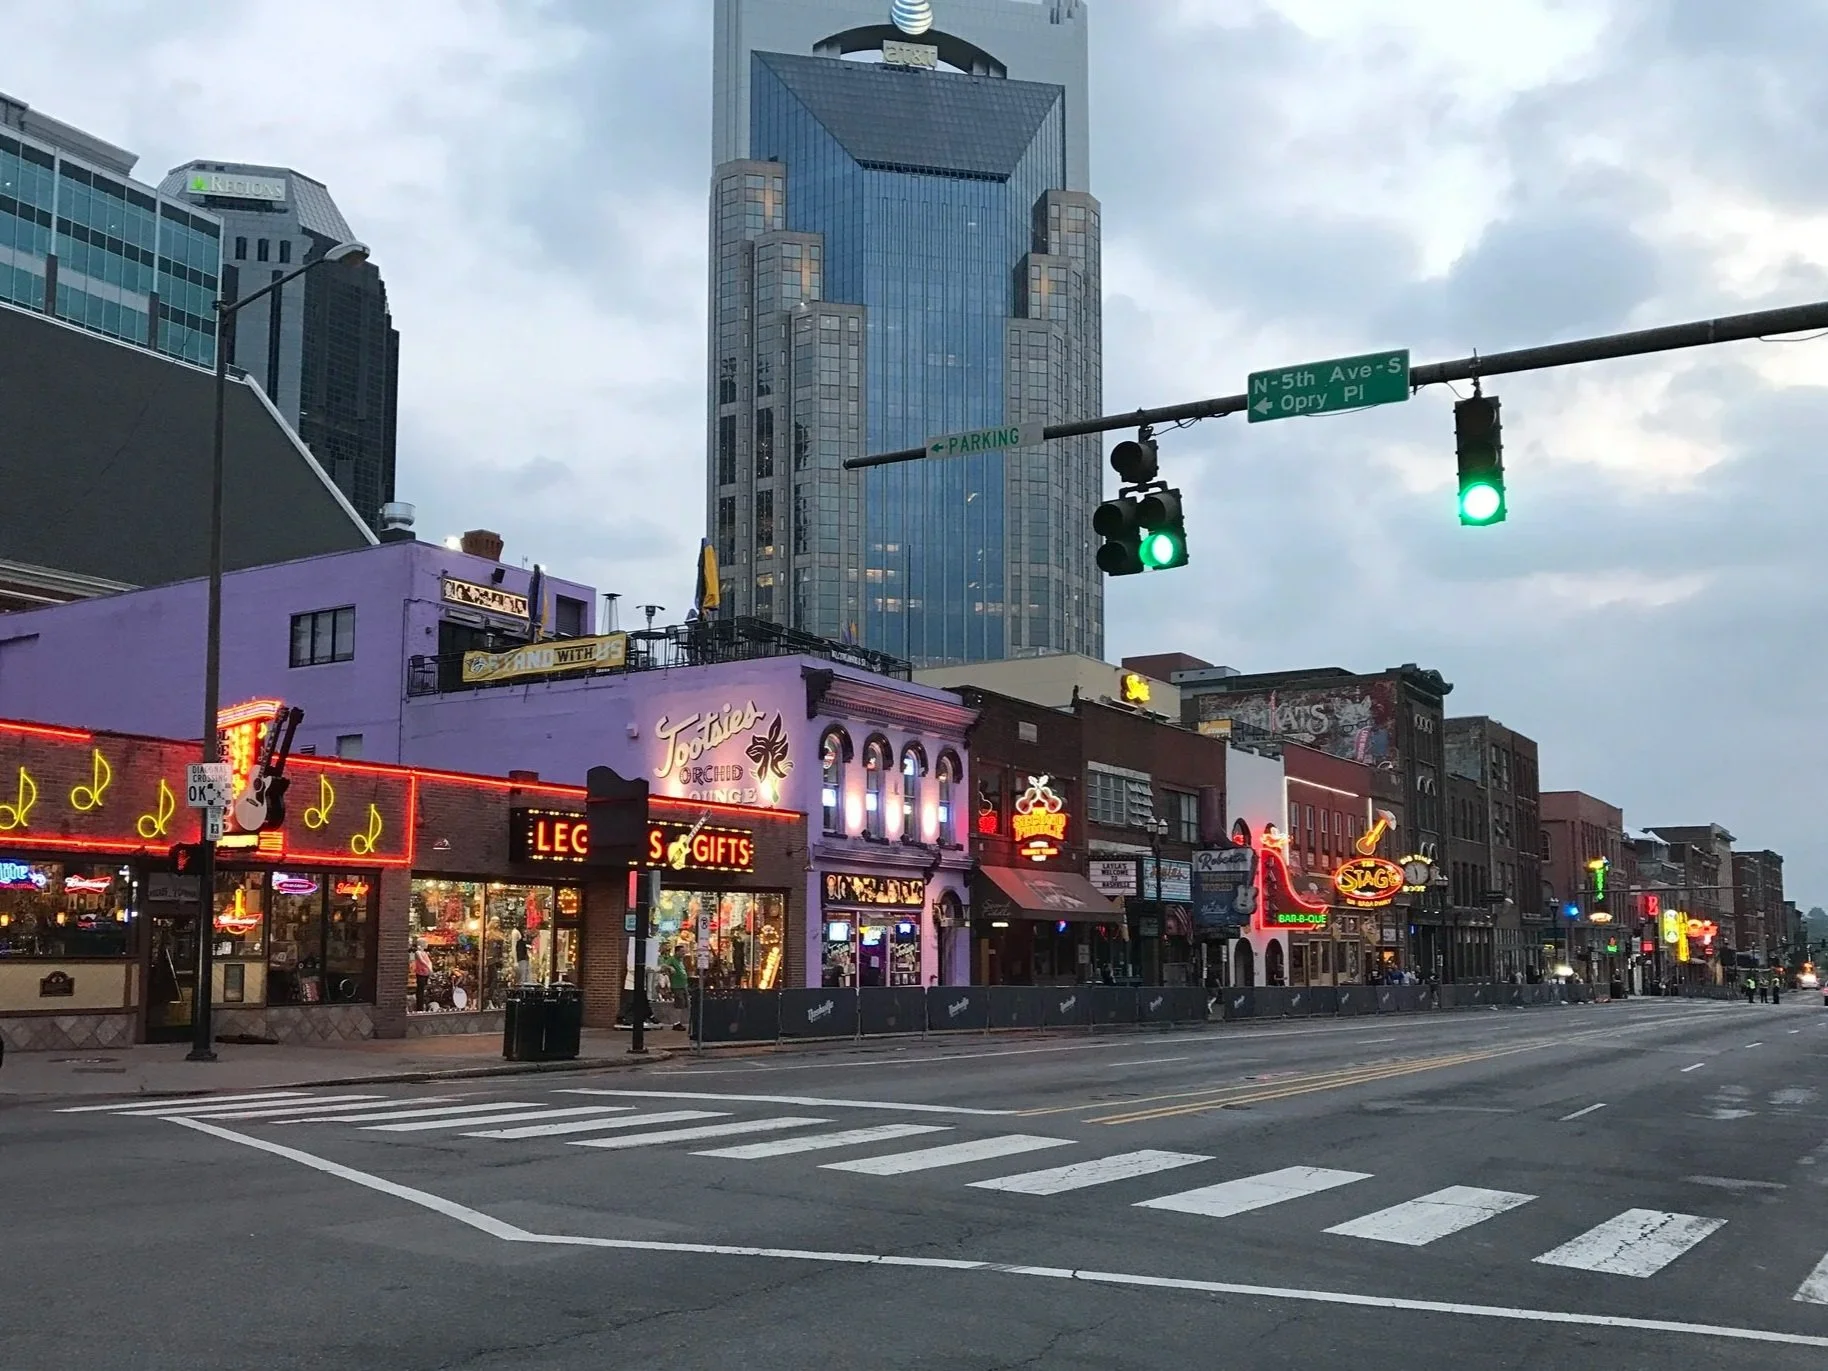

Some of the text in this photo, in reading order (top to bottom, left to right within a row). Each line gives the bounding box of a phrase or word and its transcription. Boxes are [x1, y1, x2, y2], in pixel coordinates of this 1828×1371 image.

[211, 175, 282, 198] REGIONS
[1254, 357, 1402, 394] N-5th Ave-S
[1281, 384, 1364, 412] Opry Pl
[949, 427, 1019, 455] PARKING
[557, 647, 594, 663] WITH
[653, 700, 766, 778] Tootsies
[193, 774, 228, 783] CROSSING
[679, 765, 744, 785] ORCHID
[188, 785, 207, 802] OK
[688, 787, 759, 804] OUNGE
[692, 834, 750, 866] GIFTS
[1339, 865, 1400, 892] STAGE
[1278, 914, 1327, 924] BAR-B-QUE
